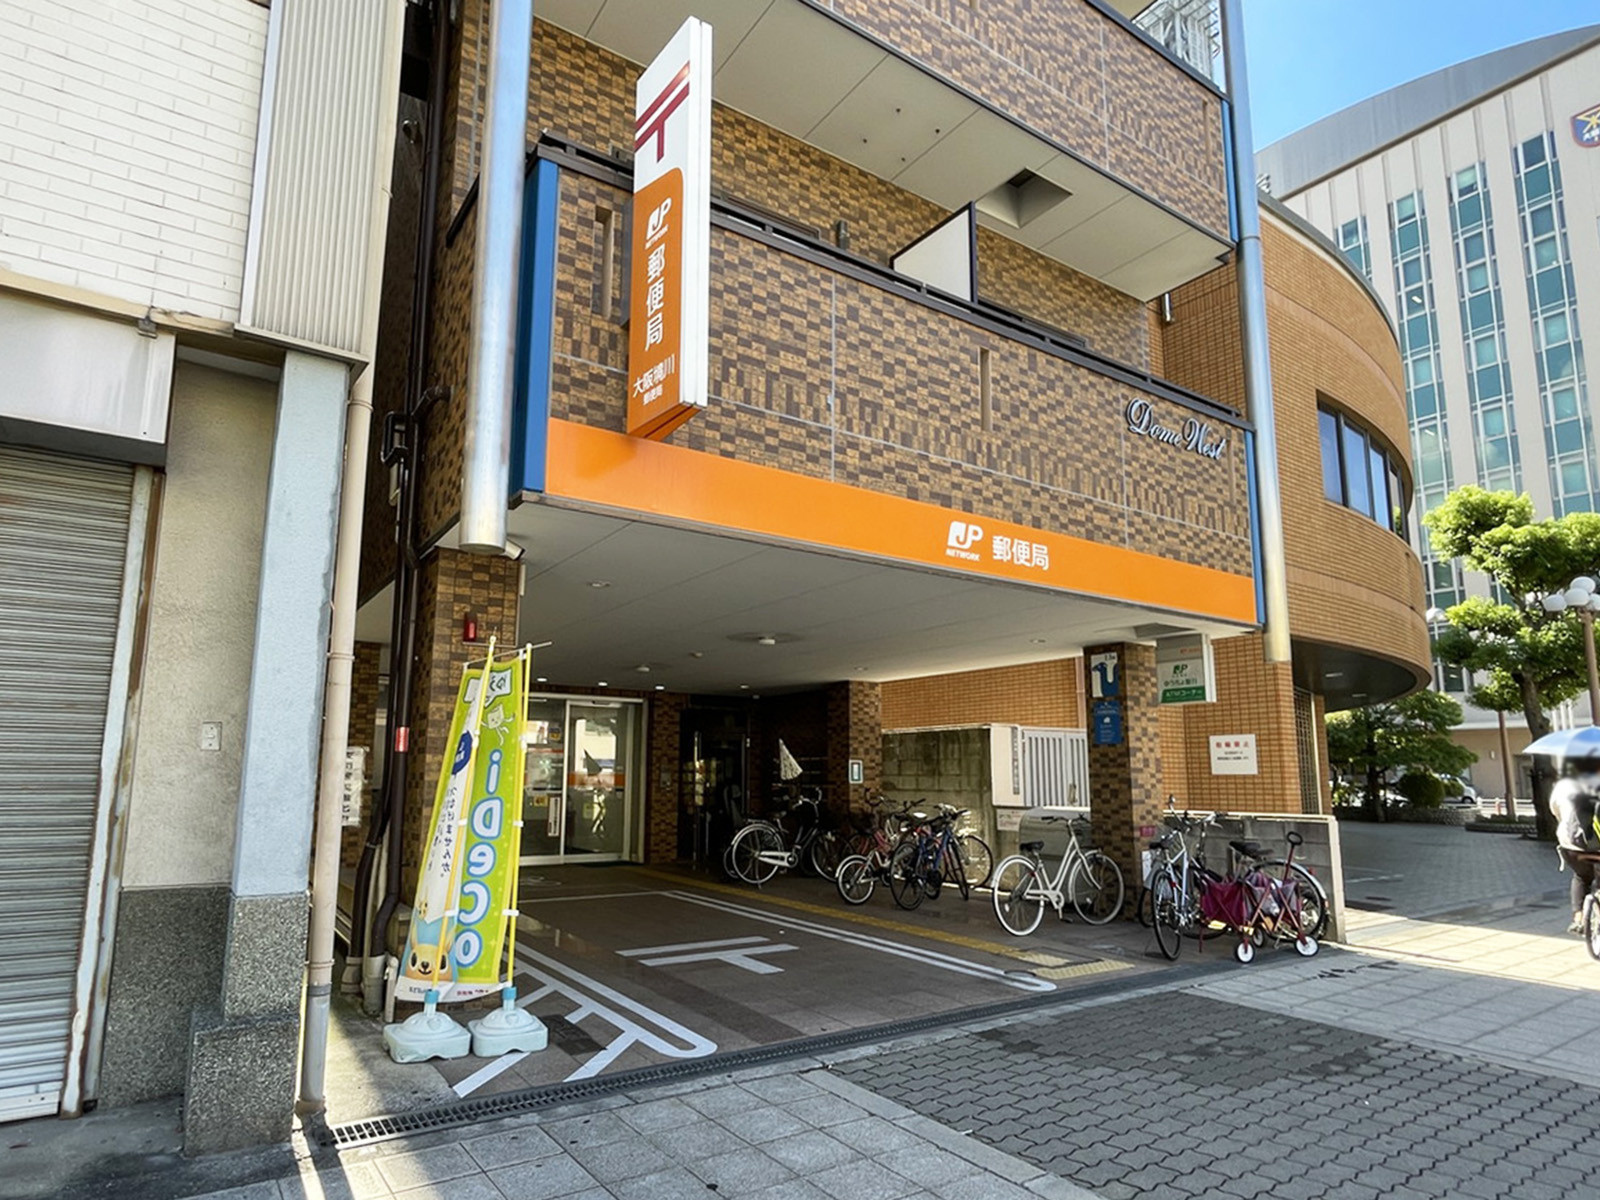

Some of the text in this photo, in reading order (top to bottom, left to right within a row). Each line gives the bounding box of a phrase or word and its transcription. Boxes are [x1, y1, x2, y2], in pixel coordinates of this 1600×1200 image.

[645, 243, 666, 352] 郵便局
[1126, 398, 1183, 447] Dome
[947, 521, 983, 549] JP
[992, 535, 1049, 571] 郵便局
